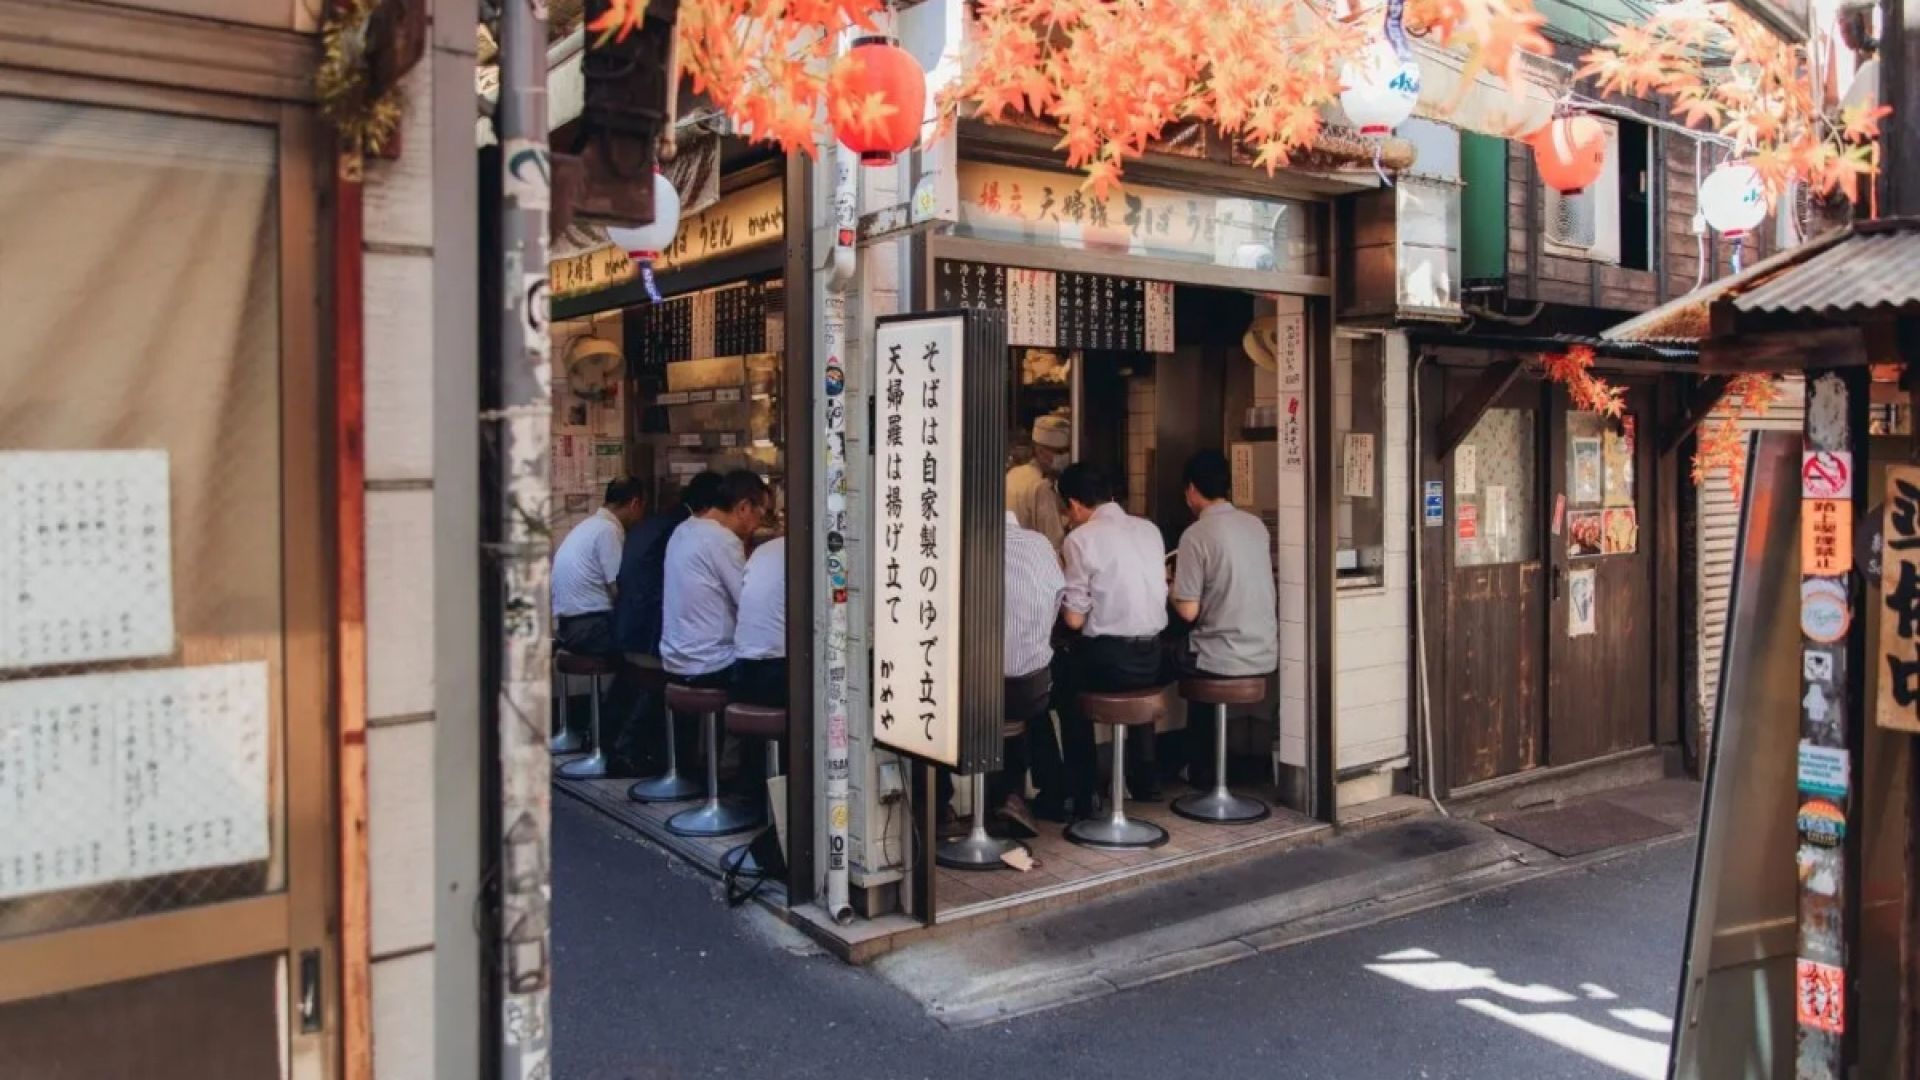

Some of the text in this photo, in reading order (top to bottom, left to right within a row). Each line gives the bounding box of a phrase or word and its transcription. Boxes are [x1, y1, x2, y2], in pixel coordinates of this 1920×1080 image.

[885, 343, 904, 624] 天婦羅は揚げ立て
[919, 341, 941, 741] そばは自家製のゆで立て
[879, 659, 894, 731] かめや
